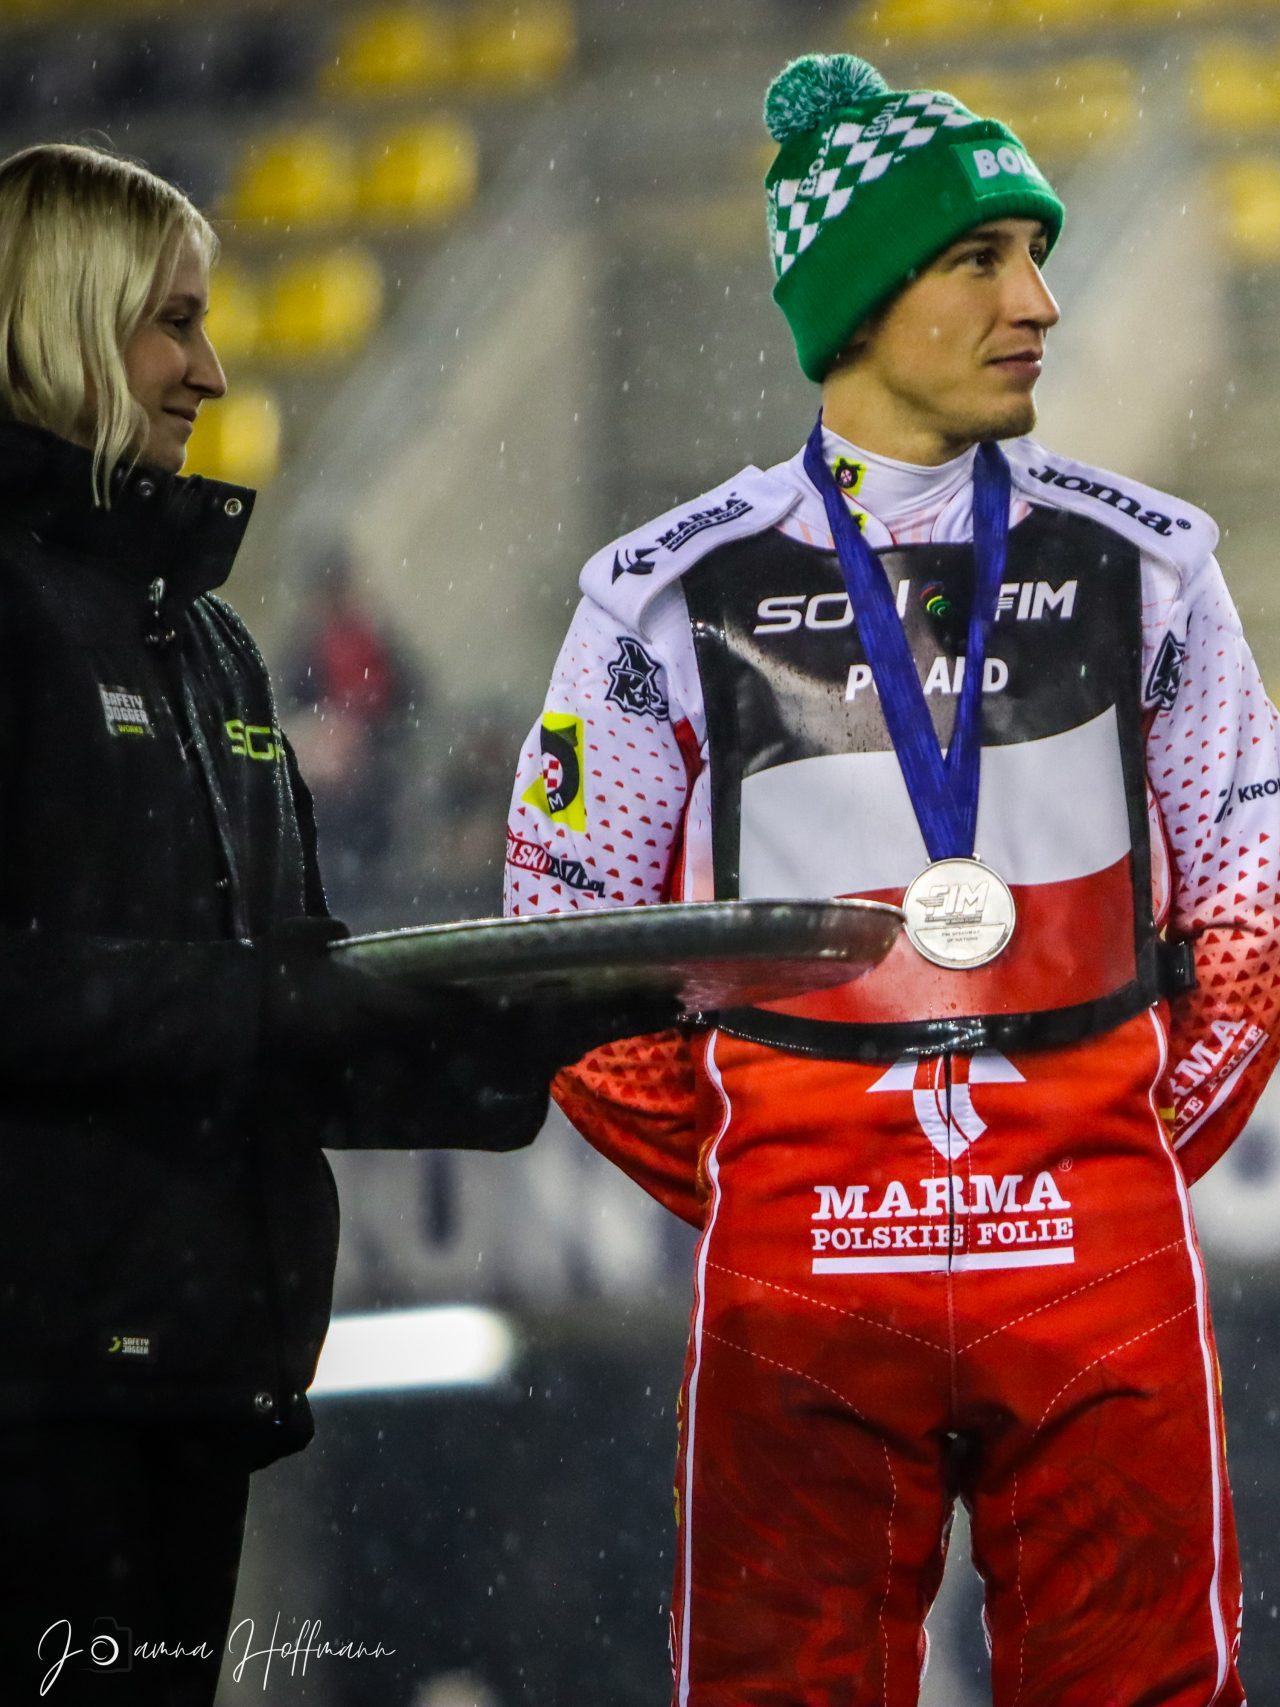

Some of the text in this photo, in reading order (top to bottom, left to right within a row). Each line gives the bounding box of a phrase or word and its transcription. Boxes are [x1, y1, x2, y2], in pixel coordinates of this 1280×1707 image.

[655, 498, 743, 547] MARMA
[994, 579, 1078, 621] FIM
[811, 1170, 1072, 1220] MARMA
[811, 1217, 1074, 1251] POLSKIE FOLIE
